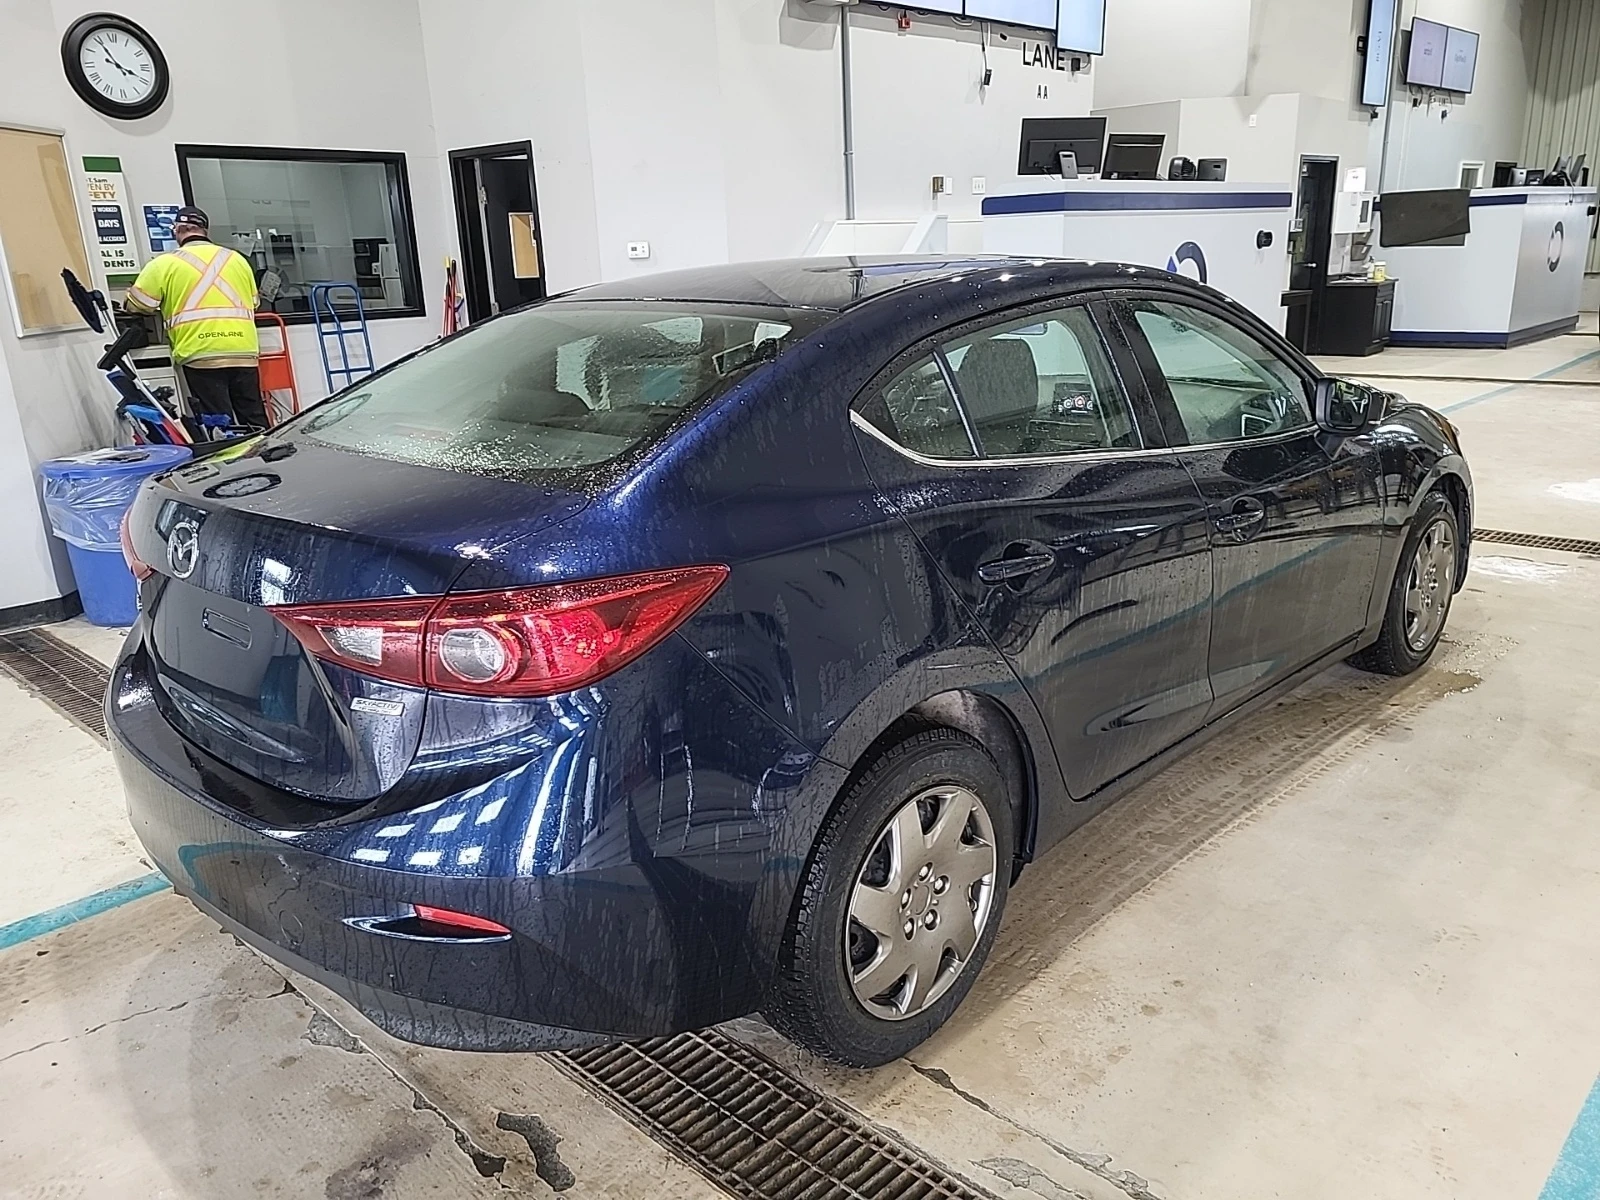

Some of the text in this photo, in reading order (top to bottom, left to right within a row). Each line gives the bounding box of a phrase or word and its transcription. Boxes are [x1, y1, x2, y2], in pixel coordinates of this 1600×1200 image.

[1022, 41, 1066, 71] LANE
[103, 183, 115, 191] BY
[98, 219, 120, 228] DAYS
[104, 260, 136, 268] DENTS
[198, 331, 244, 339] OPENLANE
[355, 699, 398, 709] SKYACTIV
